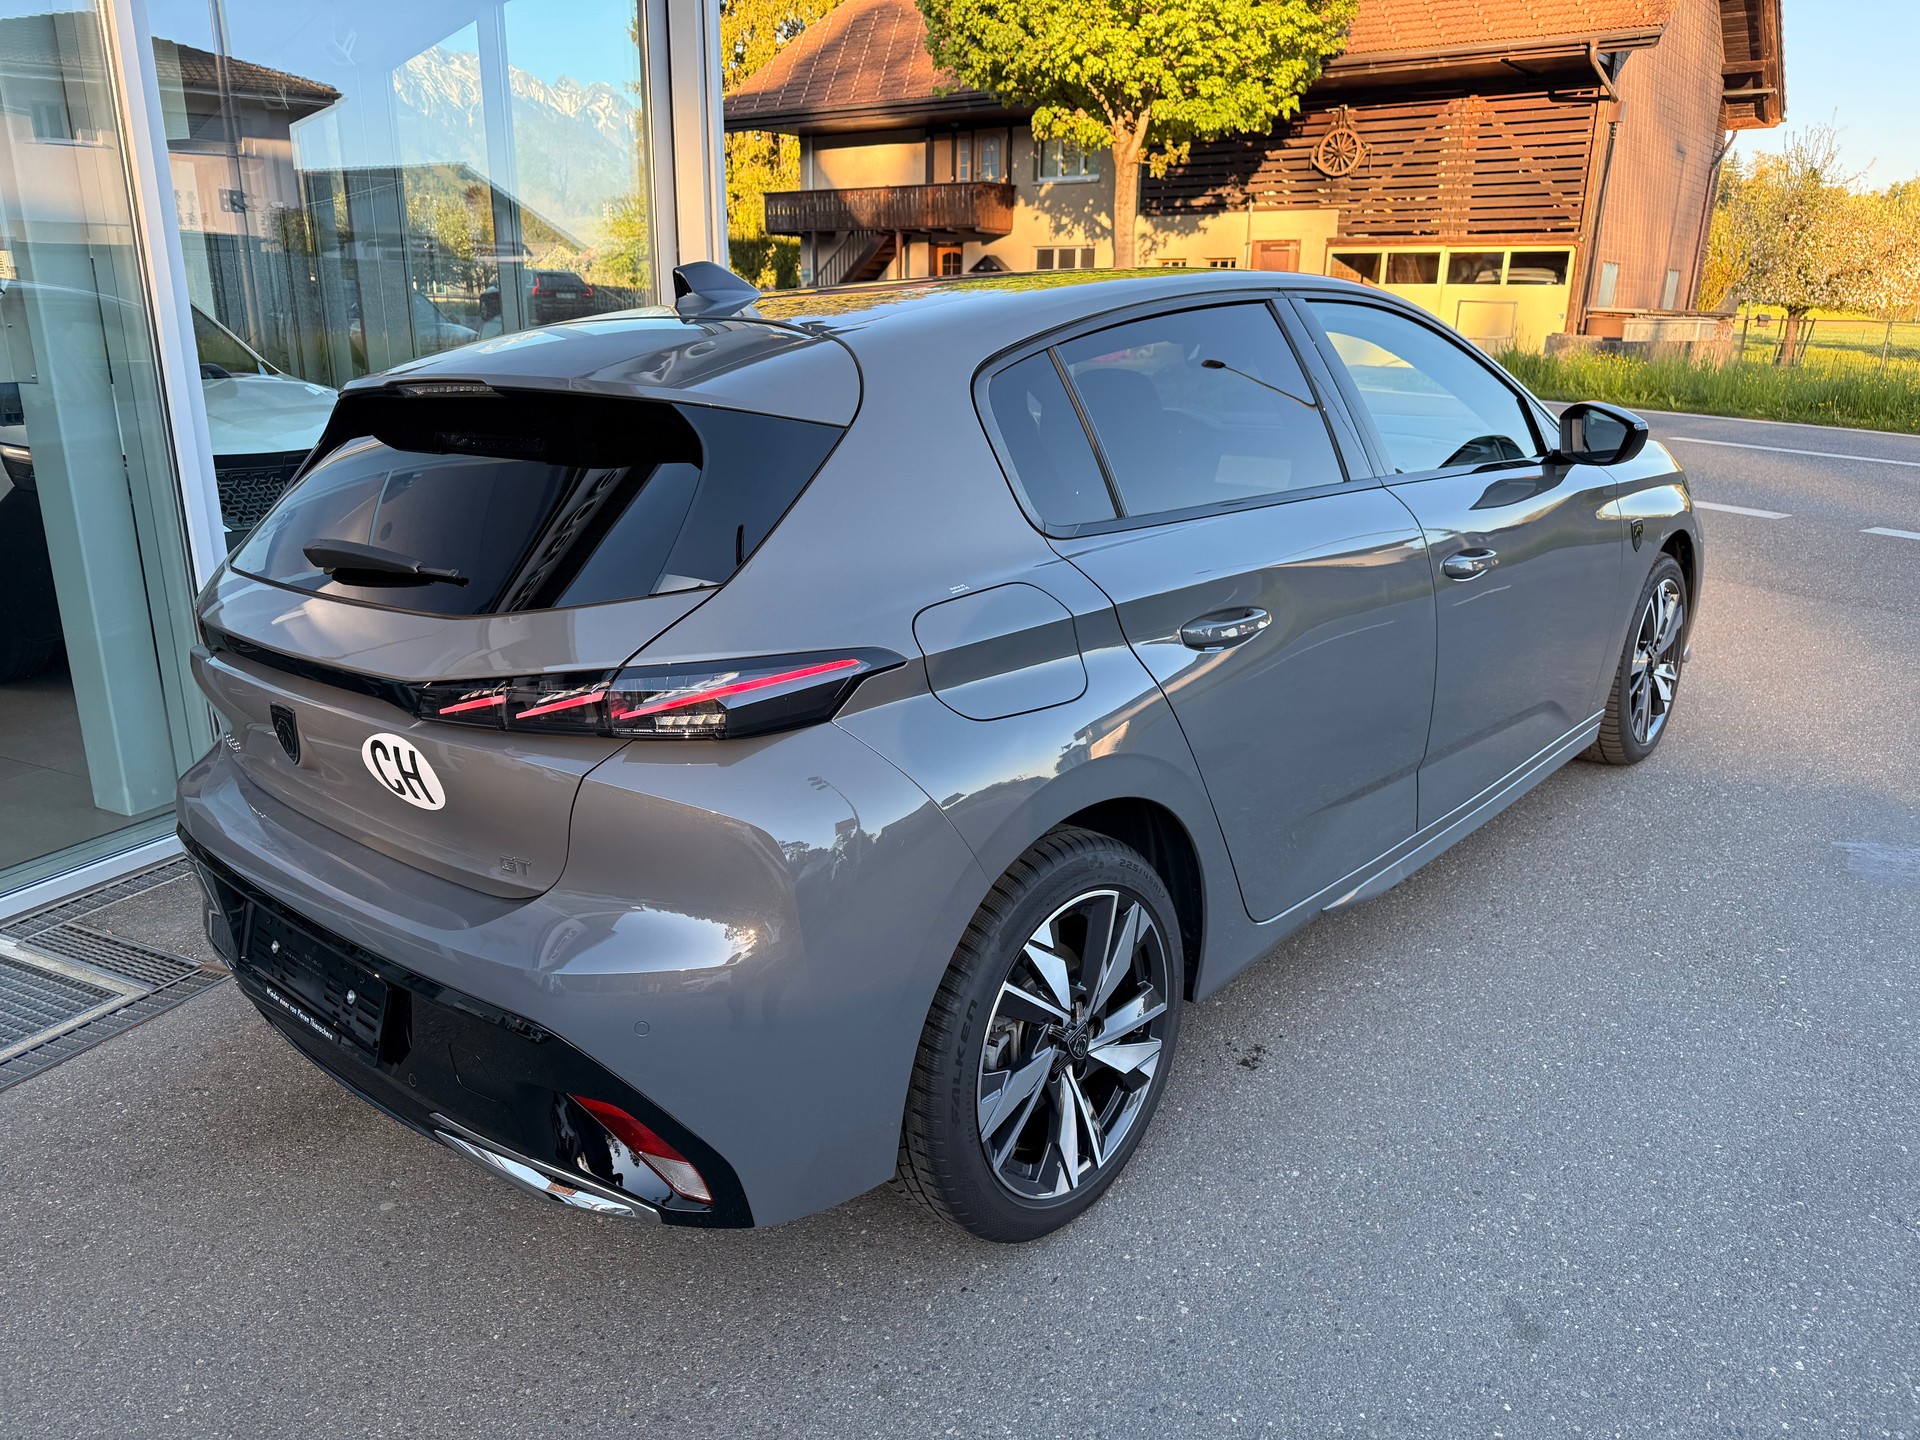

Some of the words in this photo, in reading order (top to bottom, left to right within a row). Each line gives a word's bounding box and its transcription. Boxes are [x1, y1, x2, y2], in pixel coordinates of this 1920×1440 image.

[370, 739, 436, 804] CH
[500, 854, 533, 876] GT
[952, 999, 978, 1128] FALKEN
